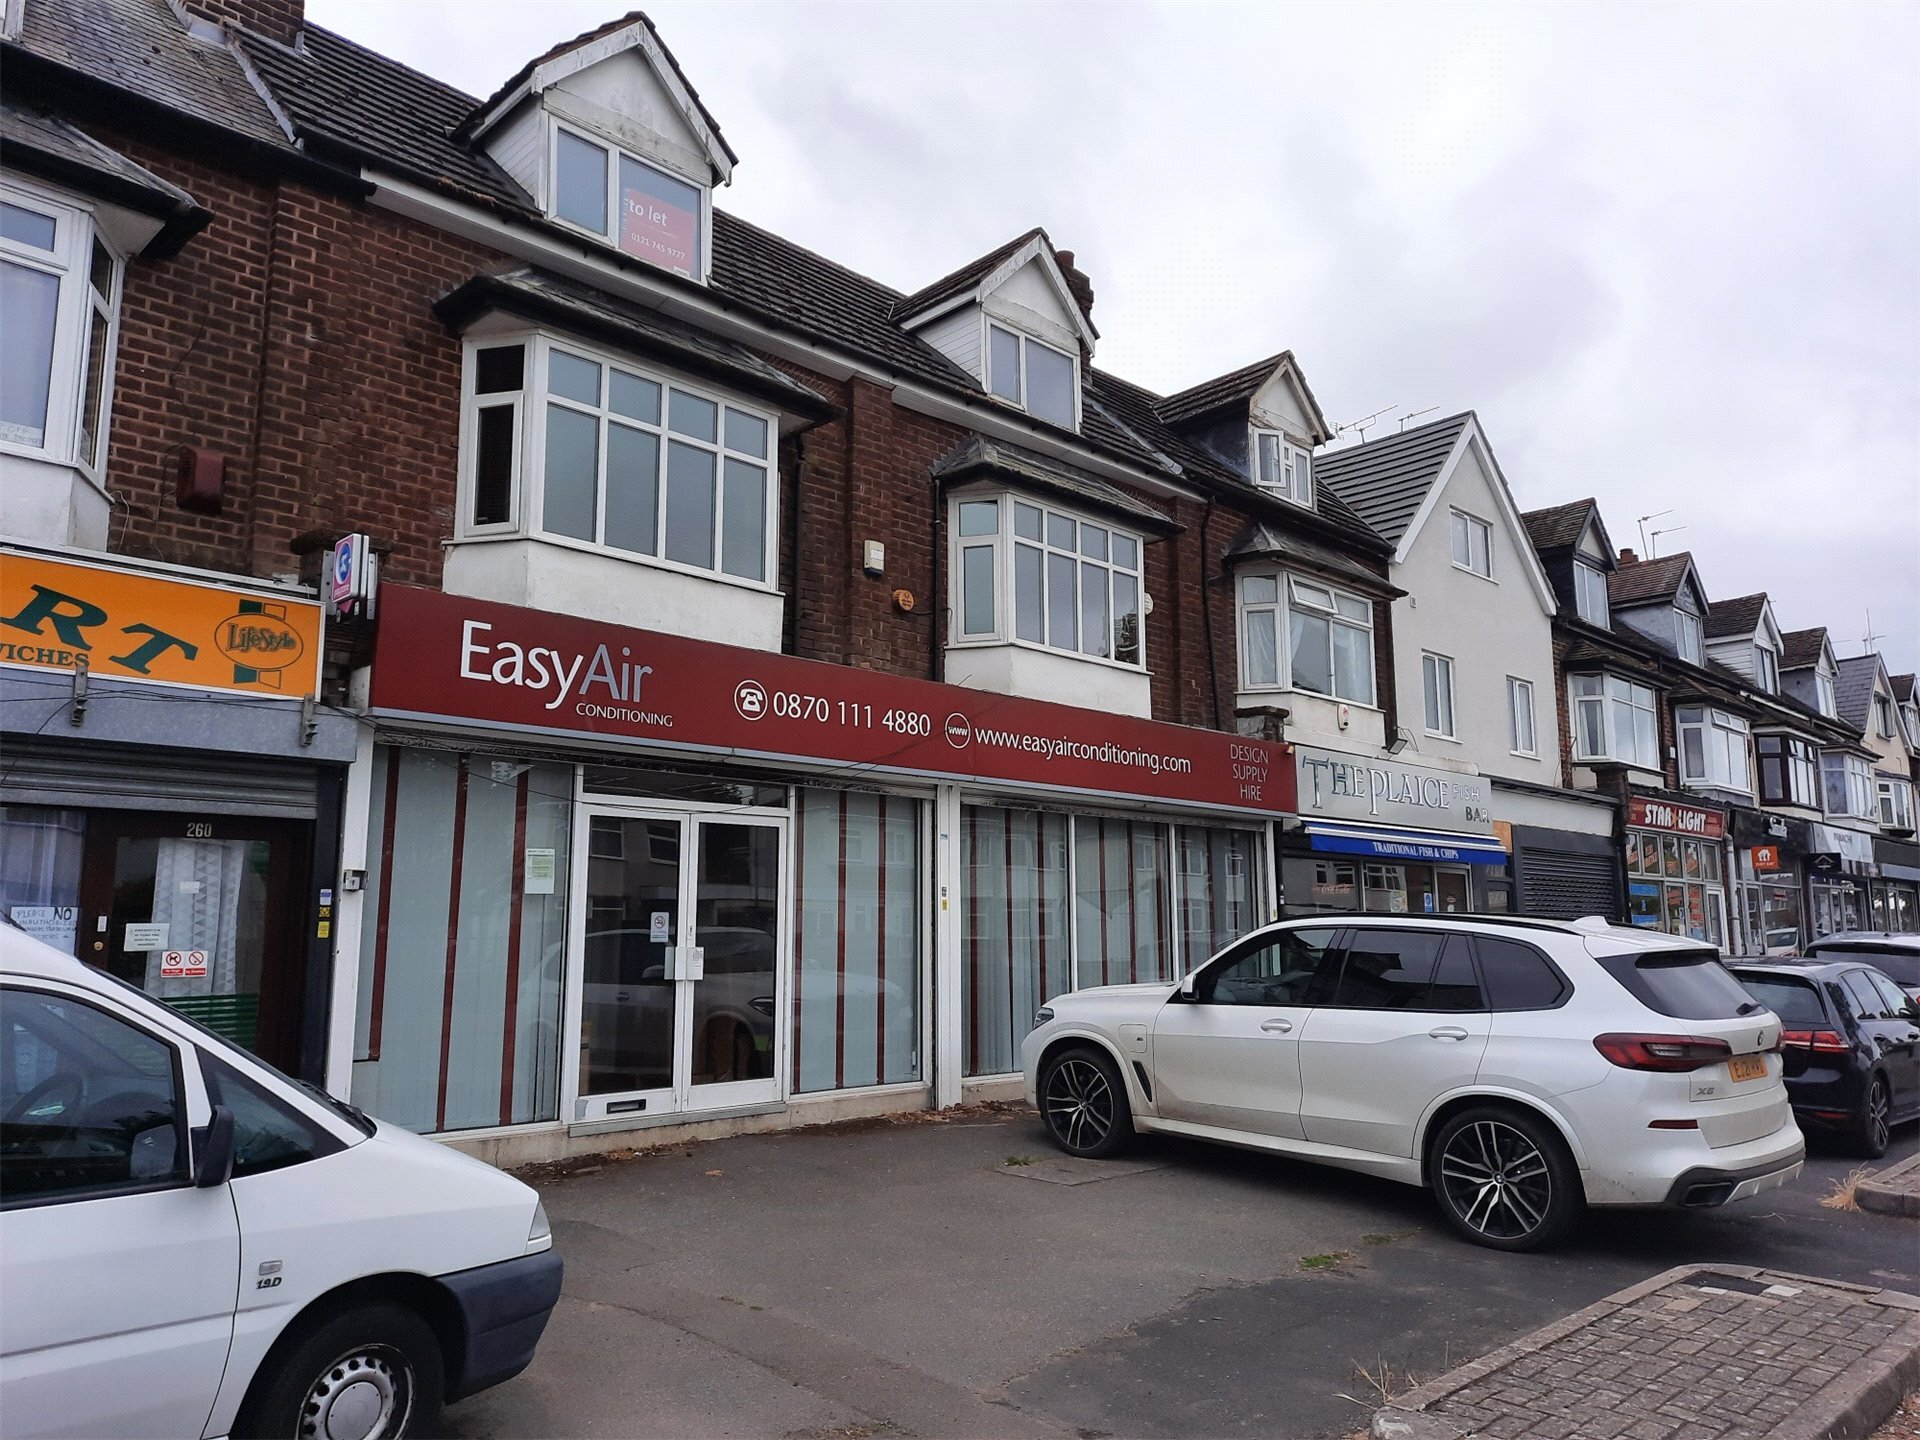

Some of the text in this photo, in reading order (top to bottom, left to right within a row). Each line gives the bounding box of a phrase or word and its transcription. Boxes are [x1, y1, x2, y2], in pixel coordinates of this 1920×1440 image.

[629, 199, 667, 227] to let
[631, 232, 685, 260] 0121 745 9777
[226, 623, 297, 653] LifeStyle
[0, 642, 90, 667] ICHES
[575, 702, 673, 727] CONDITIONING
[773, 691, 931, 737] 0870 111 4880
[975, 727, 1192, 775] www.easyairconditioning.com
[1230, 743, 1269, 765] DESIGN
[1232, 763, 1268, 783] SUPPLY
[1302, 755, 1450, 816] THE PLAICE
[1239, 784, 1263, 801] HIRE
[1451, 783, 1481, 803] FISH
[1465, 806, 1490, 824] BAR
[1645, 803, 1673, 827] STAR
[1678, 808, 1707, 833] LIGHT
[186, 822, 212, 838] 260
[1372, 841, 1459, 859] TRADITIONAL FISH & CHIPS
[53, 906, 72, 921] NO
